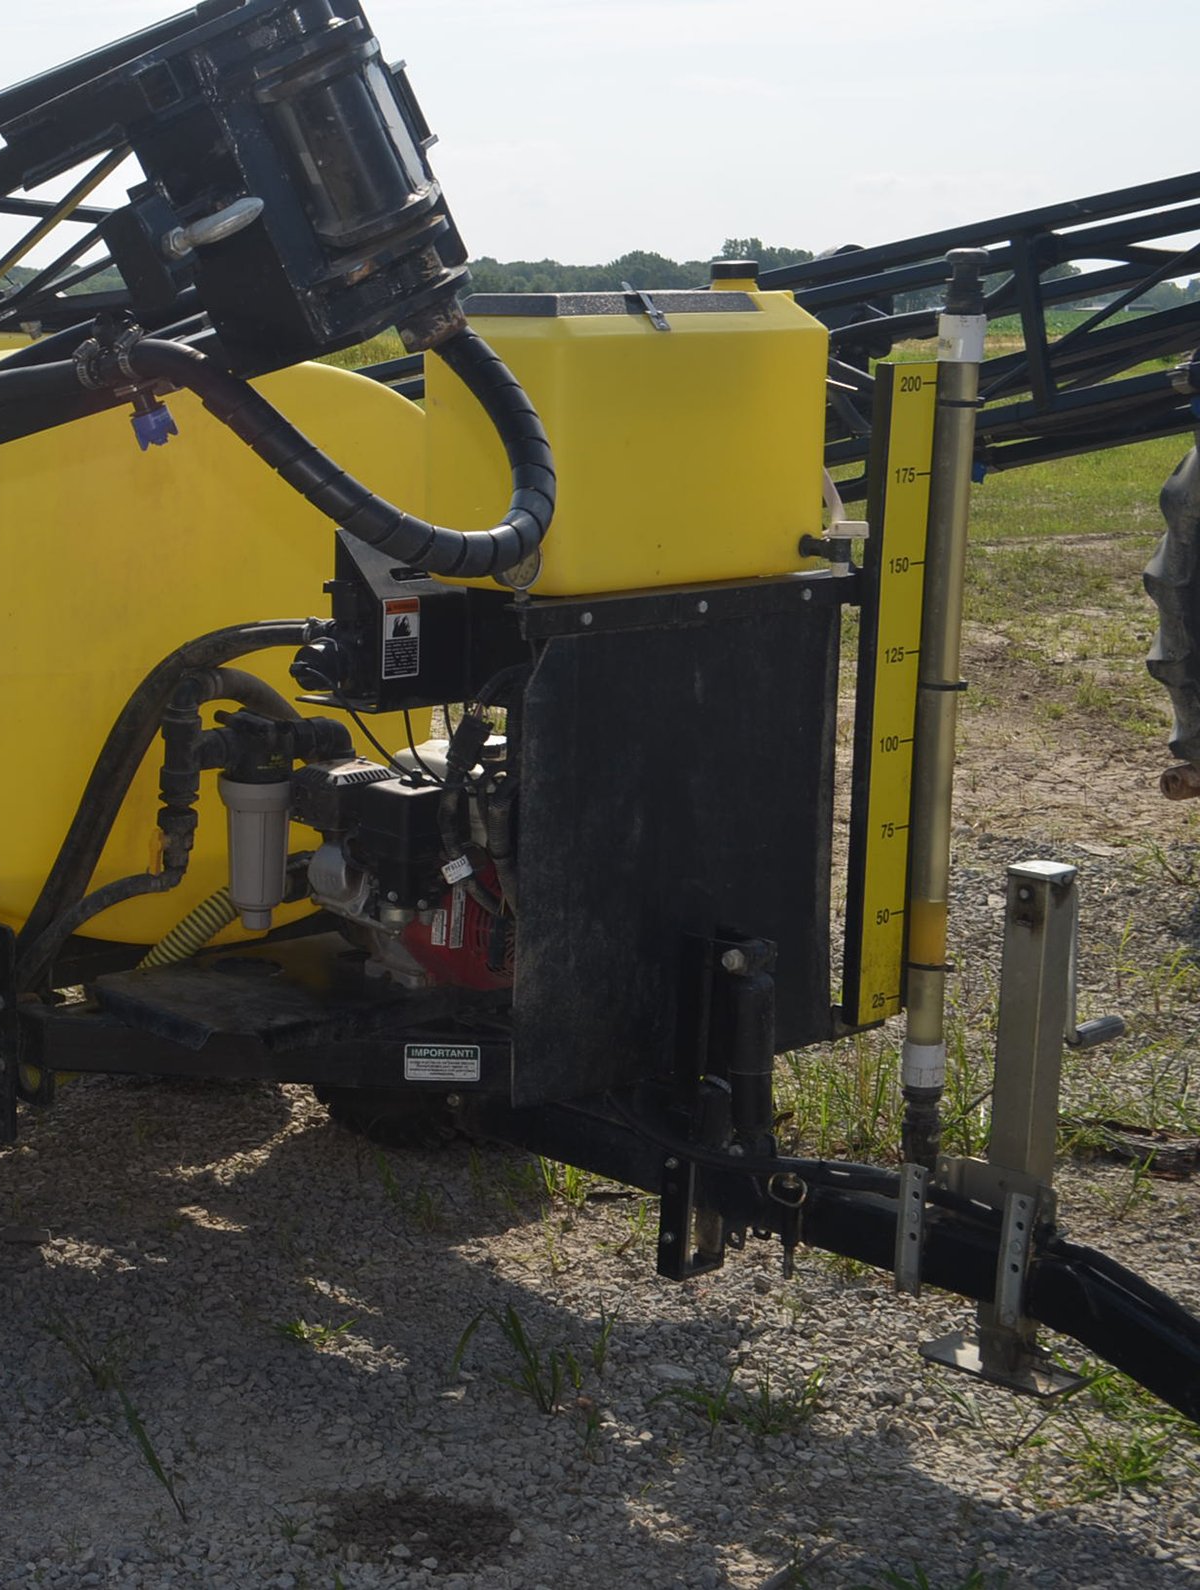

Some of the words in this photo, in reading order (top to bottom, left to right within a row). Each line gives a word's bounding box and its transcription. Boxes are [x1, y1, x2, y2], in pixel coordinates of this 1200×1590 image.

[900, 376, 922, 393] 200
[895, 467, 916, 484] 175
[889, 557, 910, 574] 150
[884, 647, 905, 664] 125
[879, 736, 899, 752] 100
[881, 823, 895, 839] 75
[876, 909, 890, 926] 50
[871, 993, 887, 1009] 25
[411, 1048, 474, 1058] IMPORTANT!
